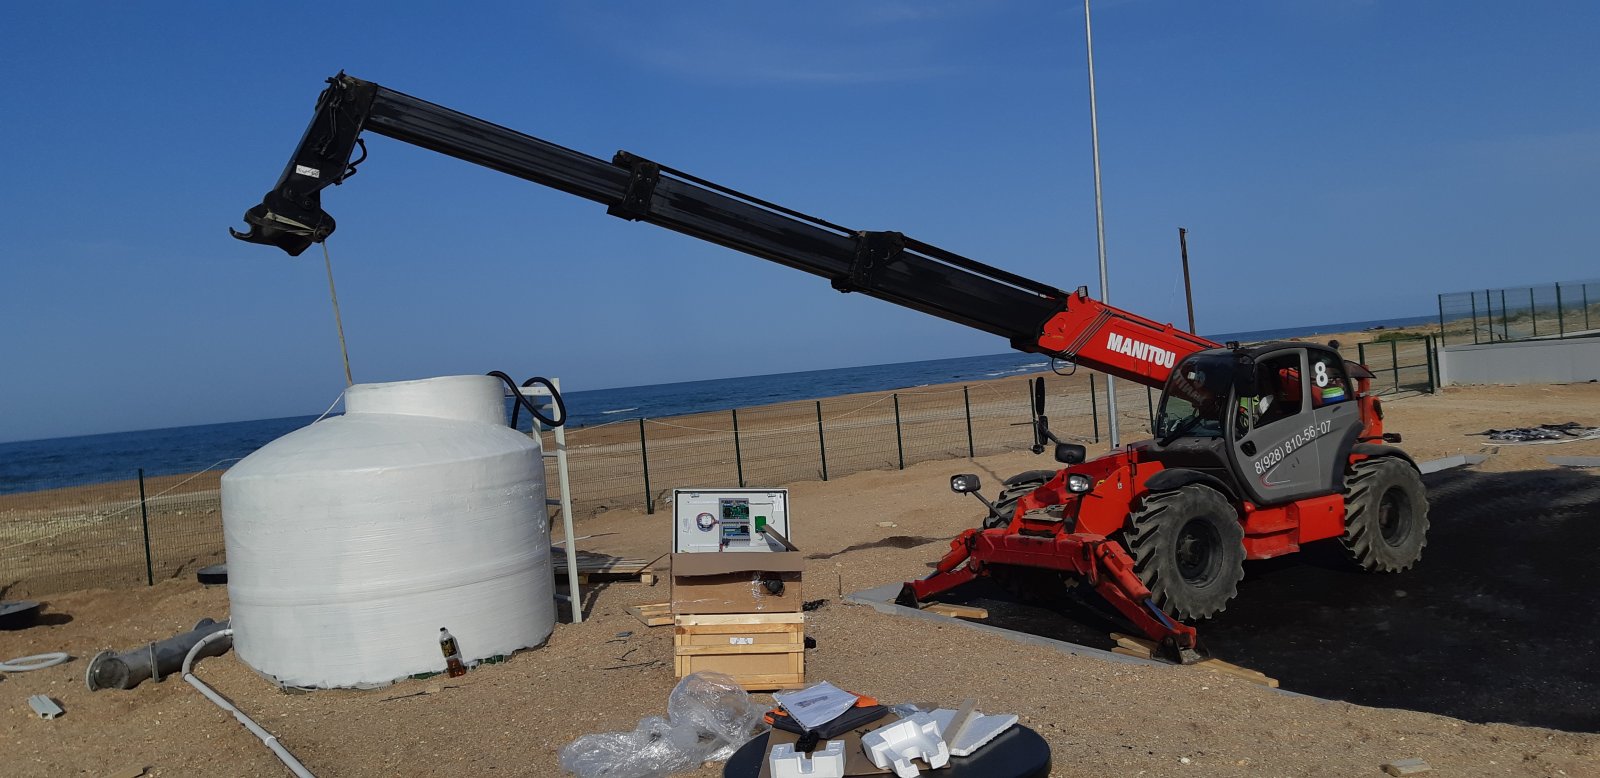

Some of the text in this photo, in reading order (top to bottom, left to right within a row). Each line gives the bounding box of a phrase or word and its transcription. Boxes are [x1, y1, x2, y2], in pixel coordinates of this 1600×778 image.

[1106, 332, 1176, 369] MANITOU
[1314, 361, 1328, 387] 8
[1254, 420, 1331, 474] 8(928) 810-56-07
